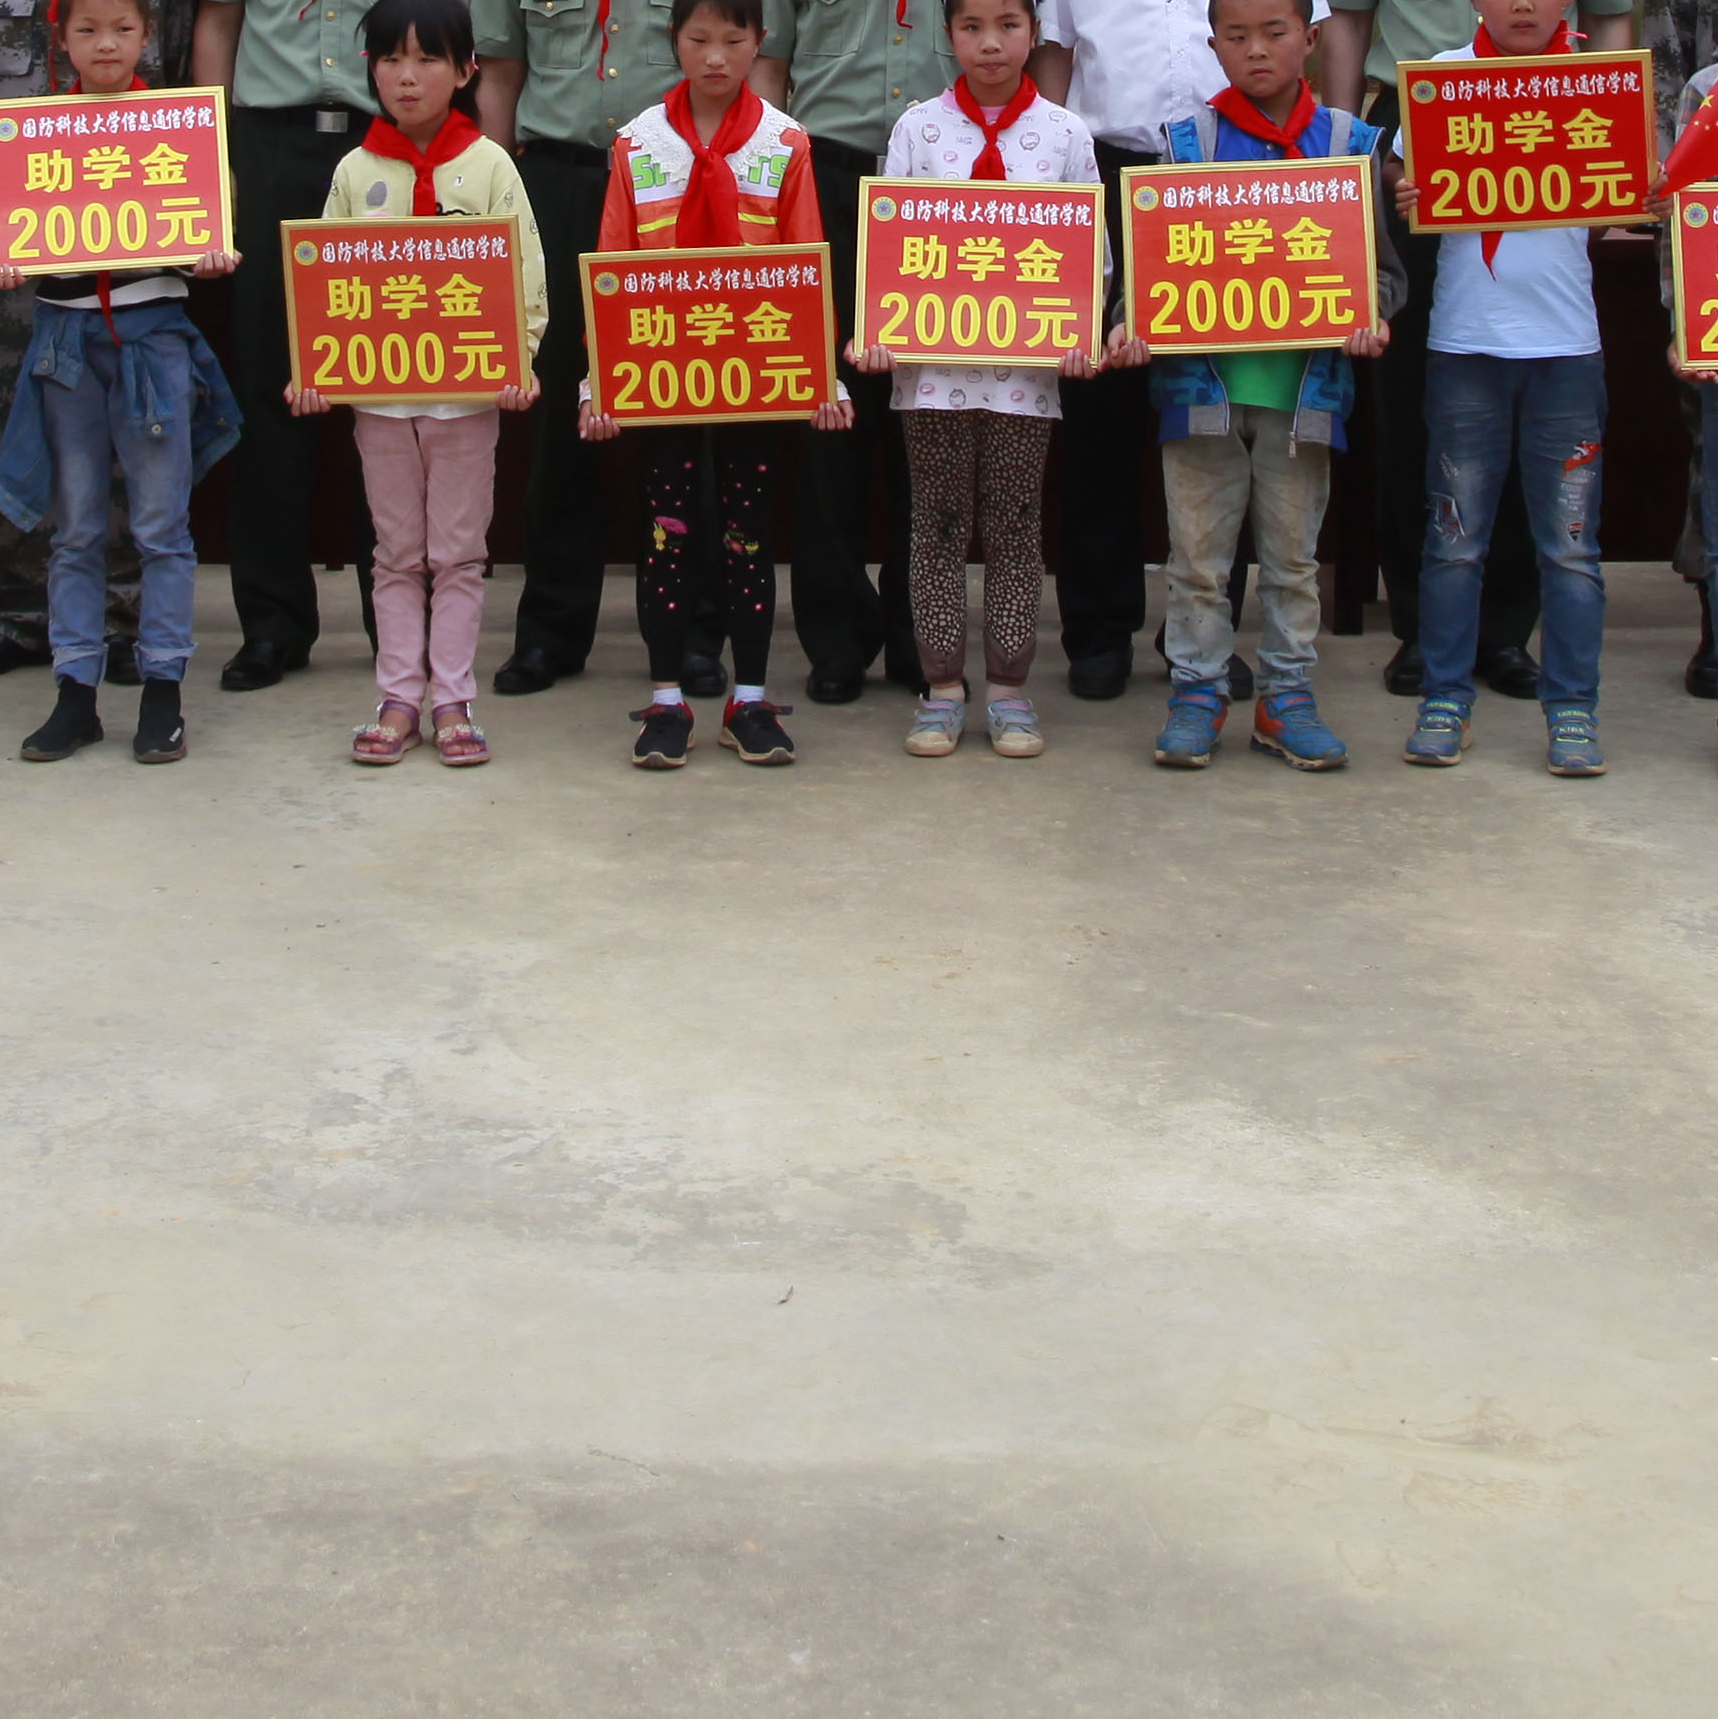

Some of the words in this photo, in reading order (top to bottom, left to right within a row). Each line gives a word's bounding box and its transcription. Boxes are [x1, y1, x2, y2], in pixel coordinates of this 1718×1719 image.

[1441, 71, 1640, 101] 国防科技大学信息通信学院
[22, 105, 216, 139] 国防科技大学信息通信学院
[1446, 108, 1613, 155] 助学金
[24, 142, 190, 193] 助学金
[1430, 161, 1636, 221] 2000元
[900, 198, 1093, 227] 国防科技大学信息通信学院
[1162, 177, 1360, 209] 国防科技大学信息通信学院
[8, 196, 212, 260] 2000元
[322, 234, 509, 264] 国防科技大学信息通信学院
[1165, 216, 1333, 267] 助学金
[624, 264, 820, 293] 国防科技大学信息通信学院
[898, 234, 1064, 283] 助学金
[326, 273, 484, 321] 助学金
[877, 291, 1080, 349] 2000元
[1149, 274, 1355, 334] 2000元
[628, 301, 793, 348] 助学金
[312, 330, 506, 386] 2000元
[612, 355, 815, 410] 2000元
